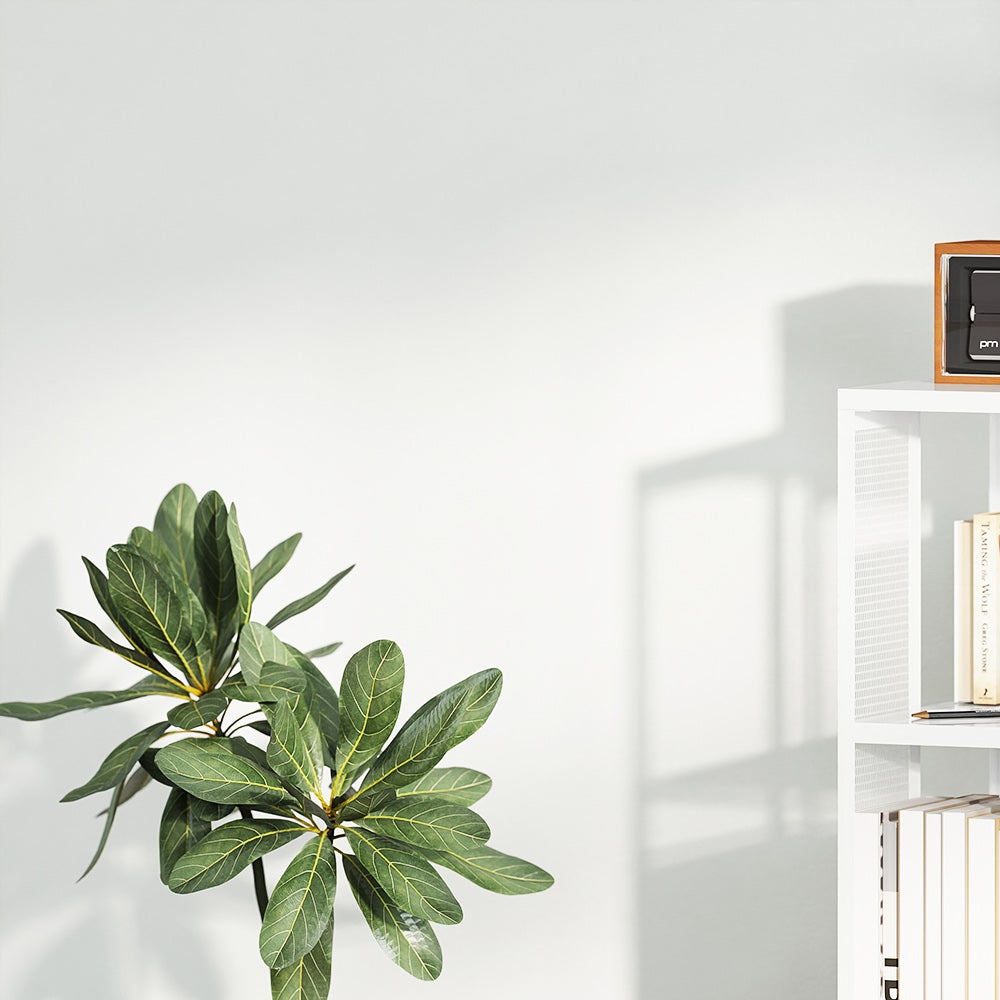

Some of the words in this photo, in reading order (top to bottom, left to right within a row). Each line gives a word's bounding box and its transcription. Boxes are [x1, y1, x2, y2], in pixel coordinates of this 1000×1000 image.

[979, 340, 999, 349] pm
[981, 521, 990, 567] TAMING
[981, 583, 990, 616] WOLF
